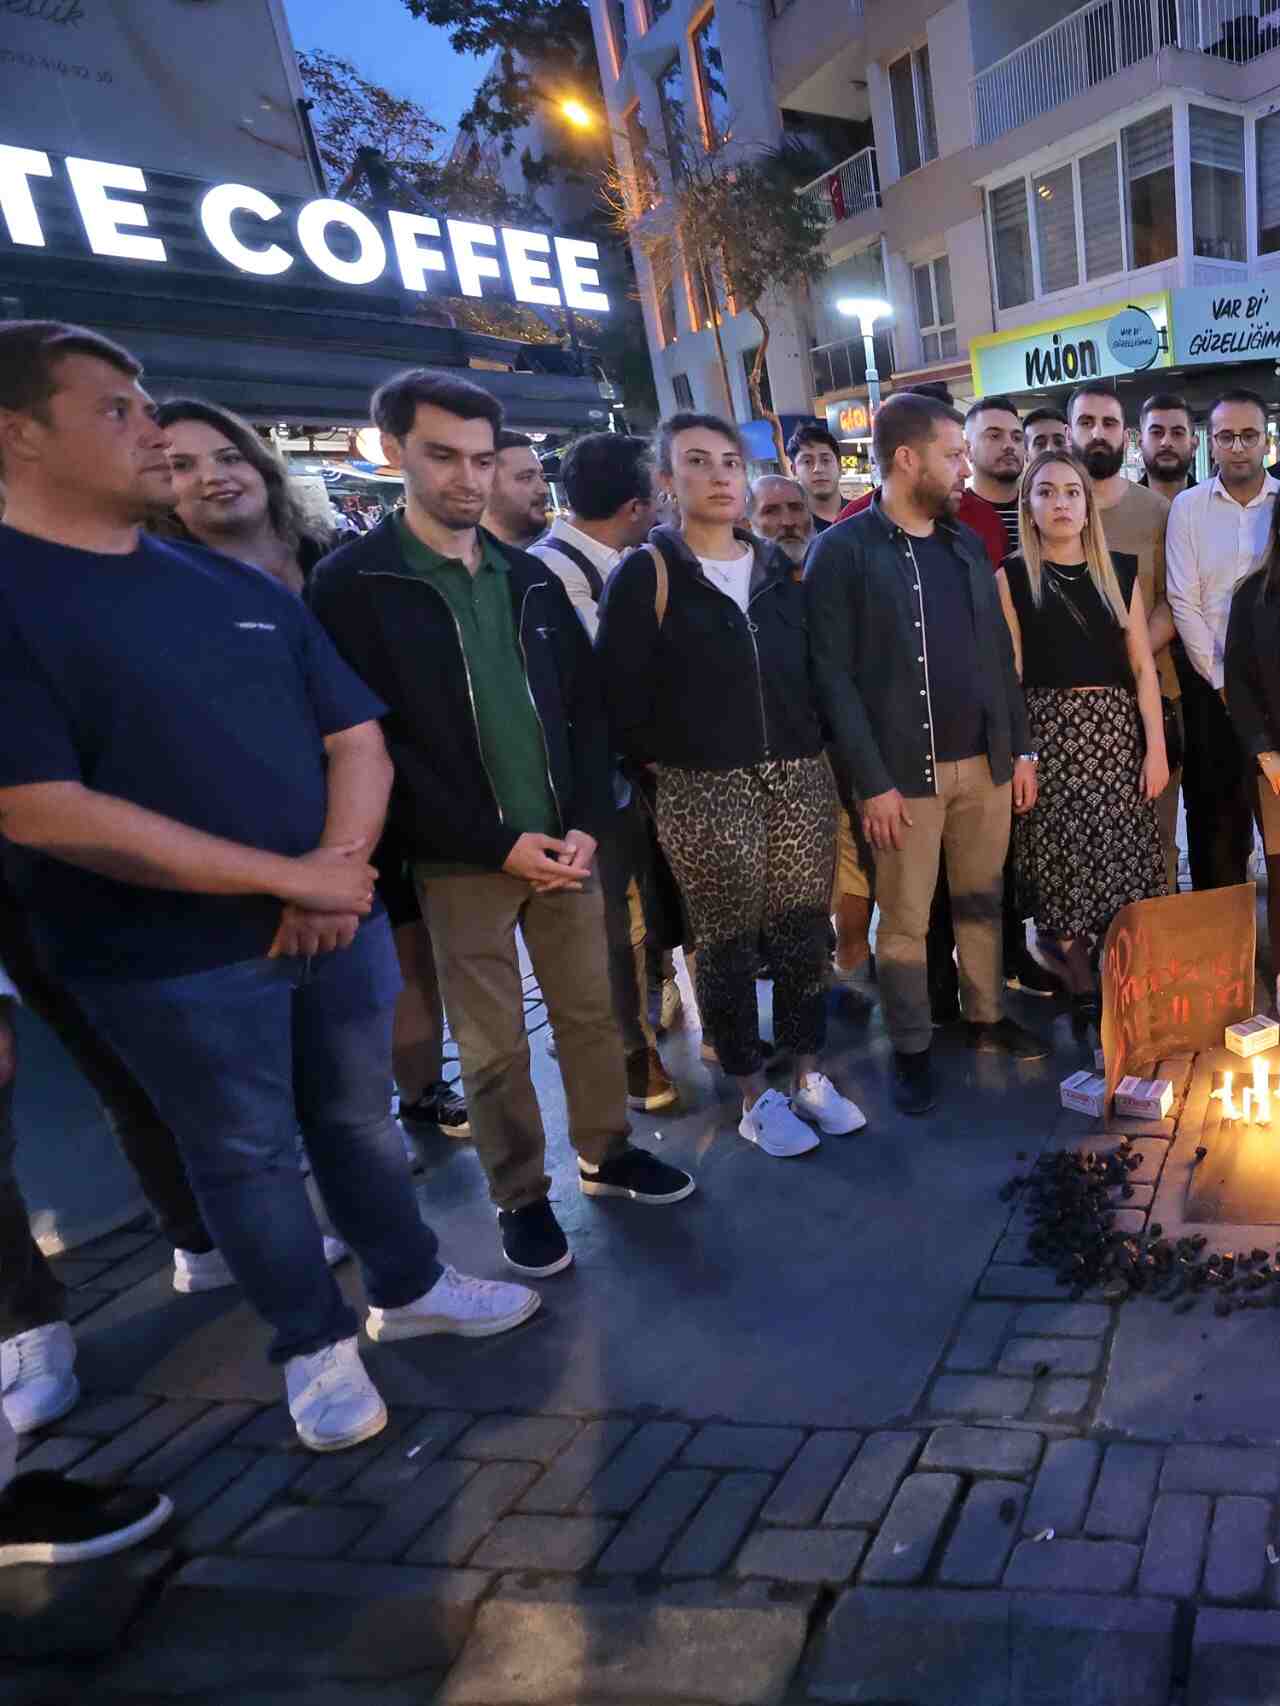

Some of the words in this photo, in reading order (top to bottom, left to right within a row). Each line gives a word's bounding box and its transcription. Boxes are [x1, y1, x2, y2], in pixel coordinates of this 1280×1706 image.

[0, 143, 167, 263] TE
[200, 182, 610, 312] COFFEE
[1212, 298, 1242, 321] VAR
[1025, 334, 1100, 387] mion
